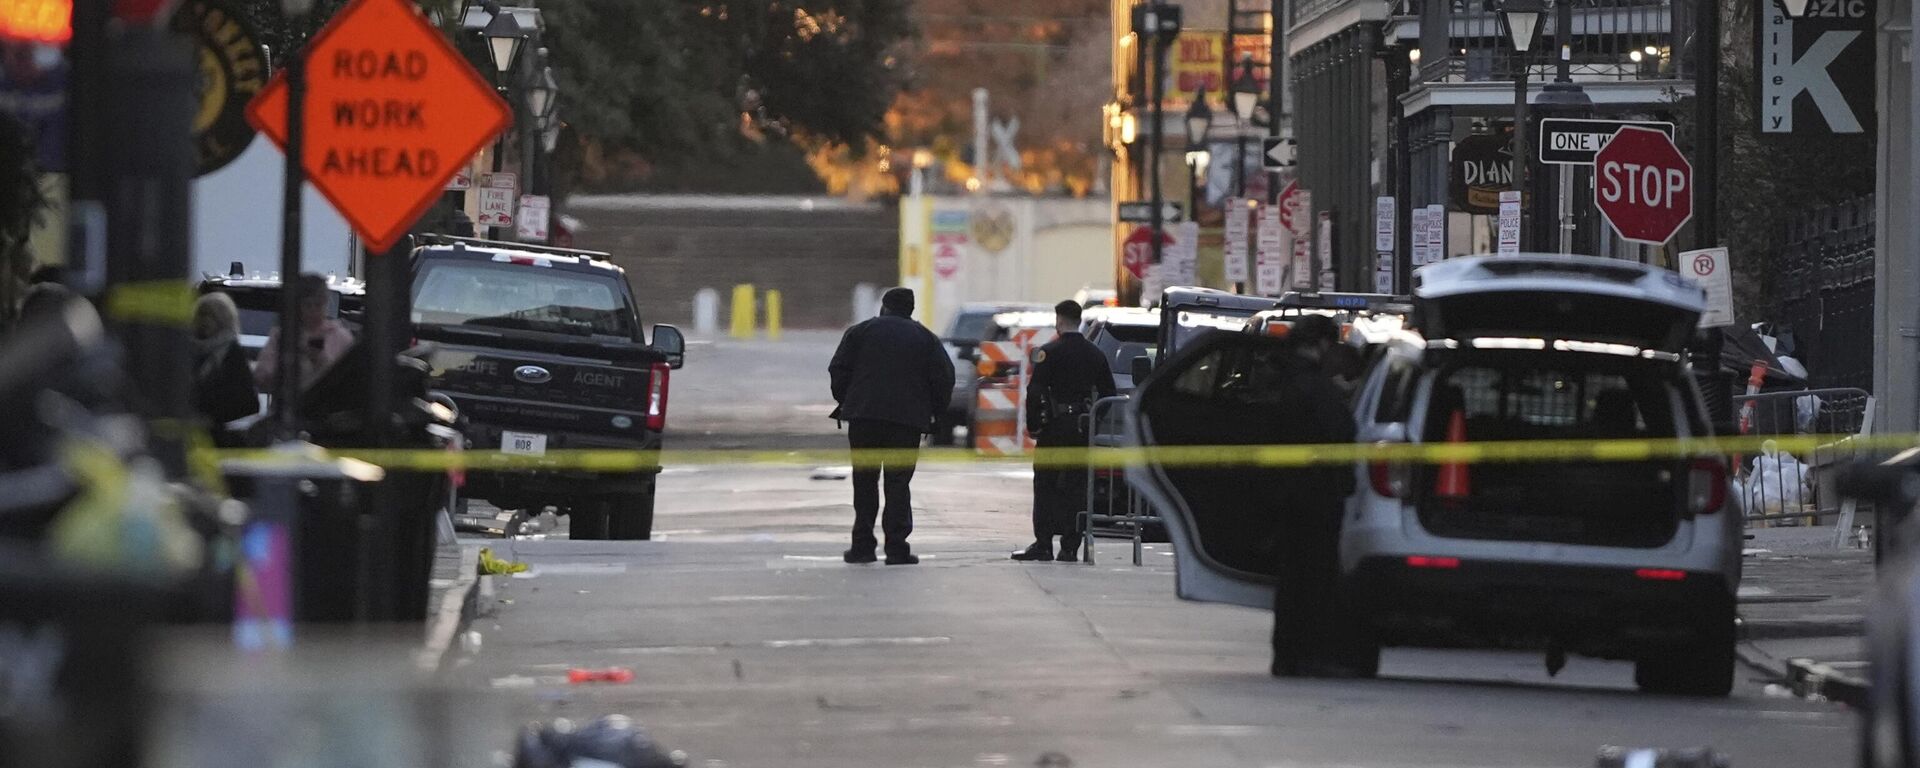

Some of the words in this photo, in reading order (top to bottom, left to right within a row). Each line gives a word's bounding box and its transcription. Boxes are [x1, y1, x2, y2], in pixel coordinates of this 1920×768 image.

[333, 48, 429, 81] ROAD
[332, 99, 426, 129] WORK
[1555, 133, 1590, 150] ONE
[321, 146, 440, 178] AHEAD
[1463, 159, 1514, 185] DIAN
[1602, 160, 1685, 209] STOP
[485, 201, 507, 212] LANE
[1413, 224, 1428, 233] POLIC
[1500, 217, 1519, 228] POLICE
[1501, 229, 1517, 240] ZONE
[572, 371, 625, 389] AGENT
